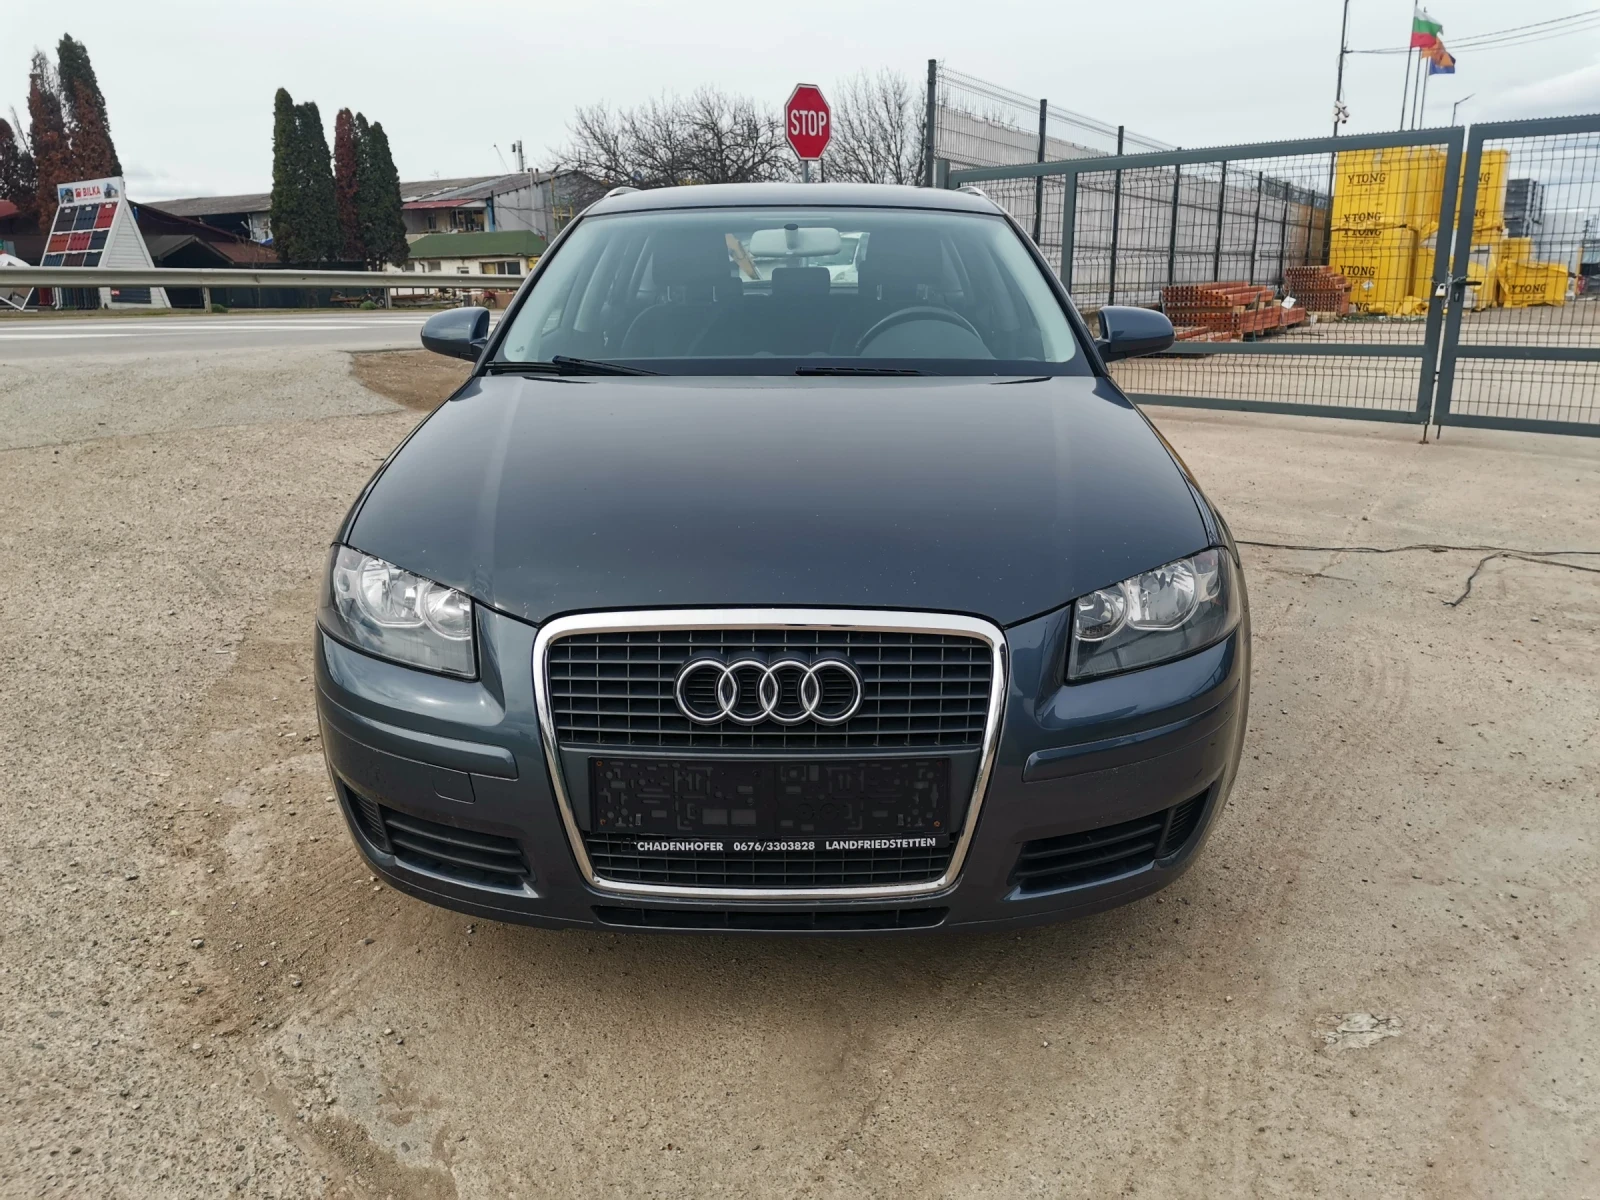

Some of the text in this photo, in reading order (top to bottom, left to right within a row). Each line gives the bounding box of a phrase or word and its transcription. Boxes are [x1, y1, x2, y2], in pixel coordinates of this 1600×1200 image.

[790, 109, 827, 136] STOP
[1348, 172, 1386, 184] YTONG
[82, 186, 101, 196] BILKA
[1344, 211, 1381, 222] YTONG
[1340, 264, 1376, 276] YTONG
[1511, 283, 1547, 293] YTONG
[634, 837, 936, 852] CHADENHOFER 0676/3303828 LANDFRIEDSTETTEN
